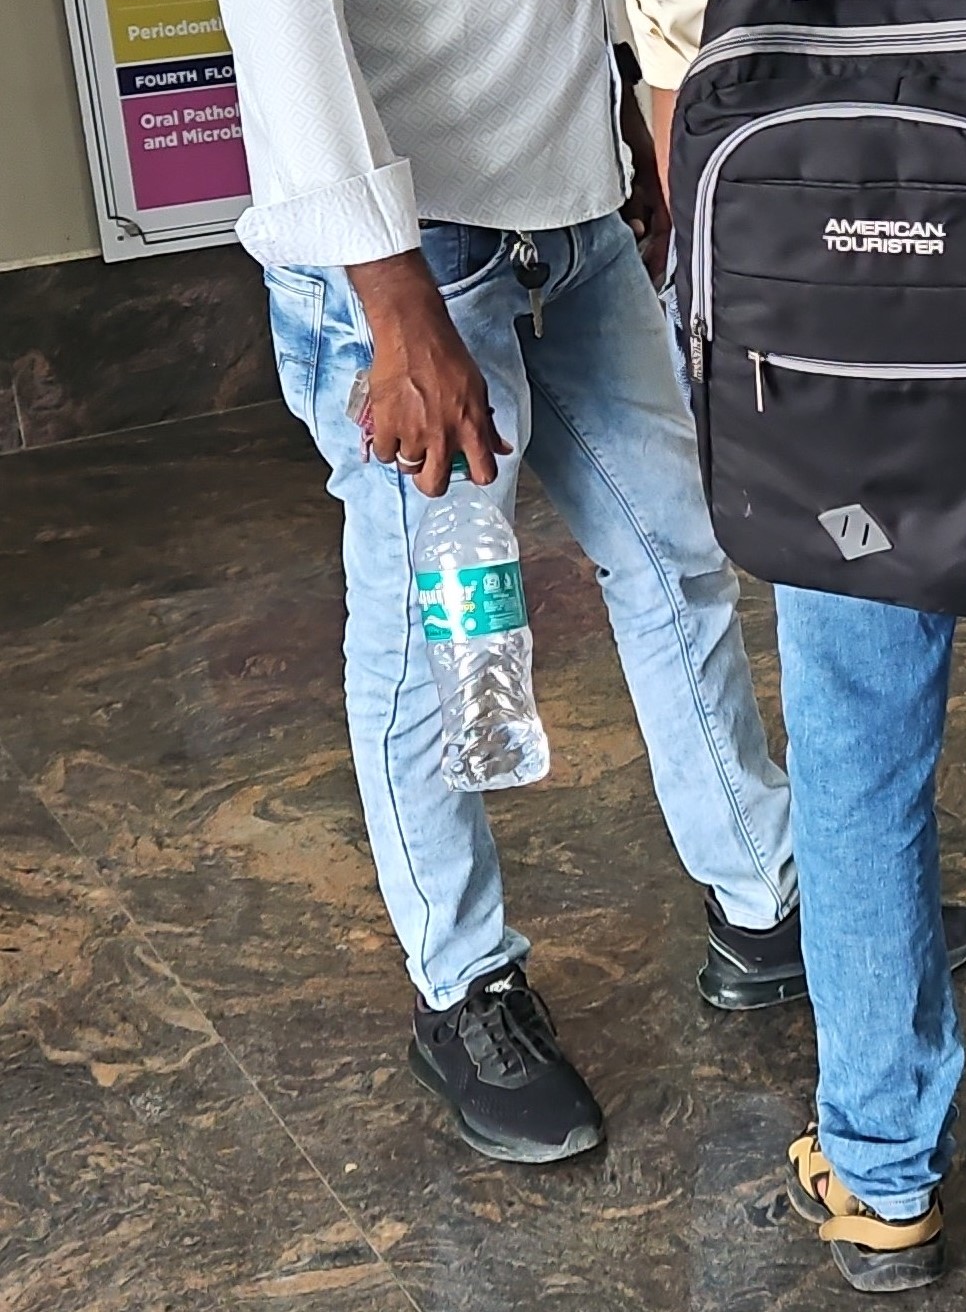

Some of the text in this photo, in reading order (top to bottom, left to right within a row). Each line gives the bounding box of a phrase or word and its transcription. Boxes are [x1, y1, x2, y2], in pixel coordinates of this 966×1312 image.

[134, 69, 197, 88] FOURTH
[140, 110, 178, 128] Oral
[143, 126, 241, 149] and Microb
[824, 218, 946, 237] AMERICAN
[822, 235, 944, 255] TOURISTER
